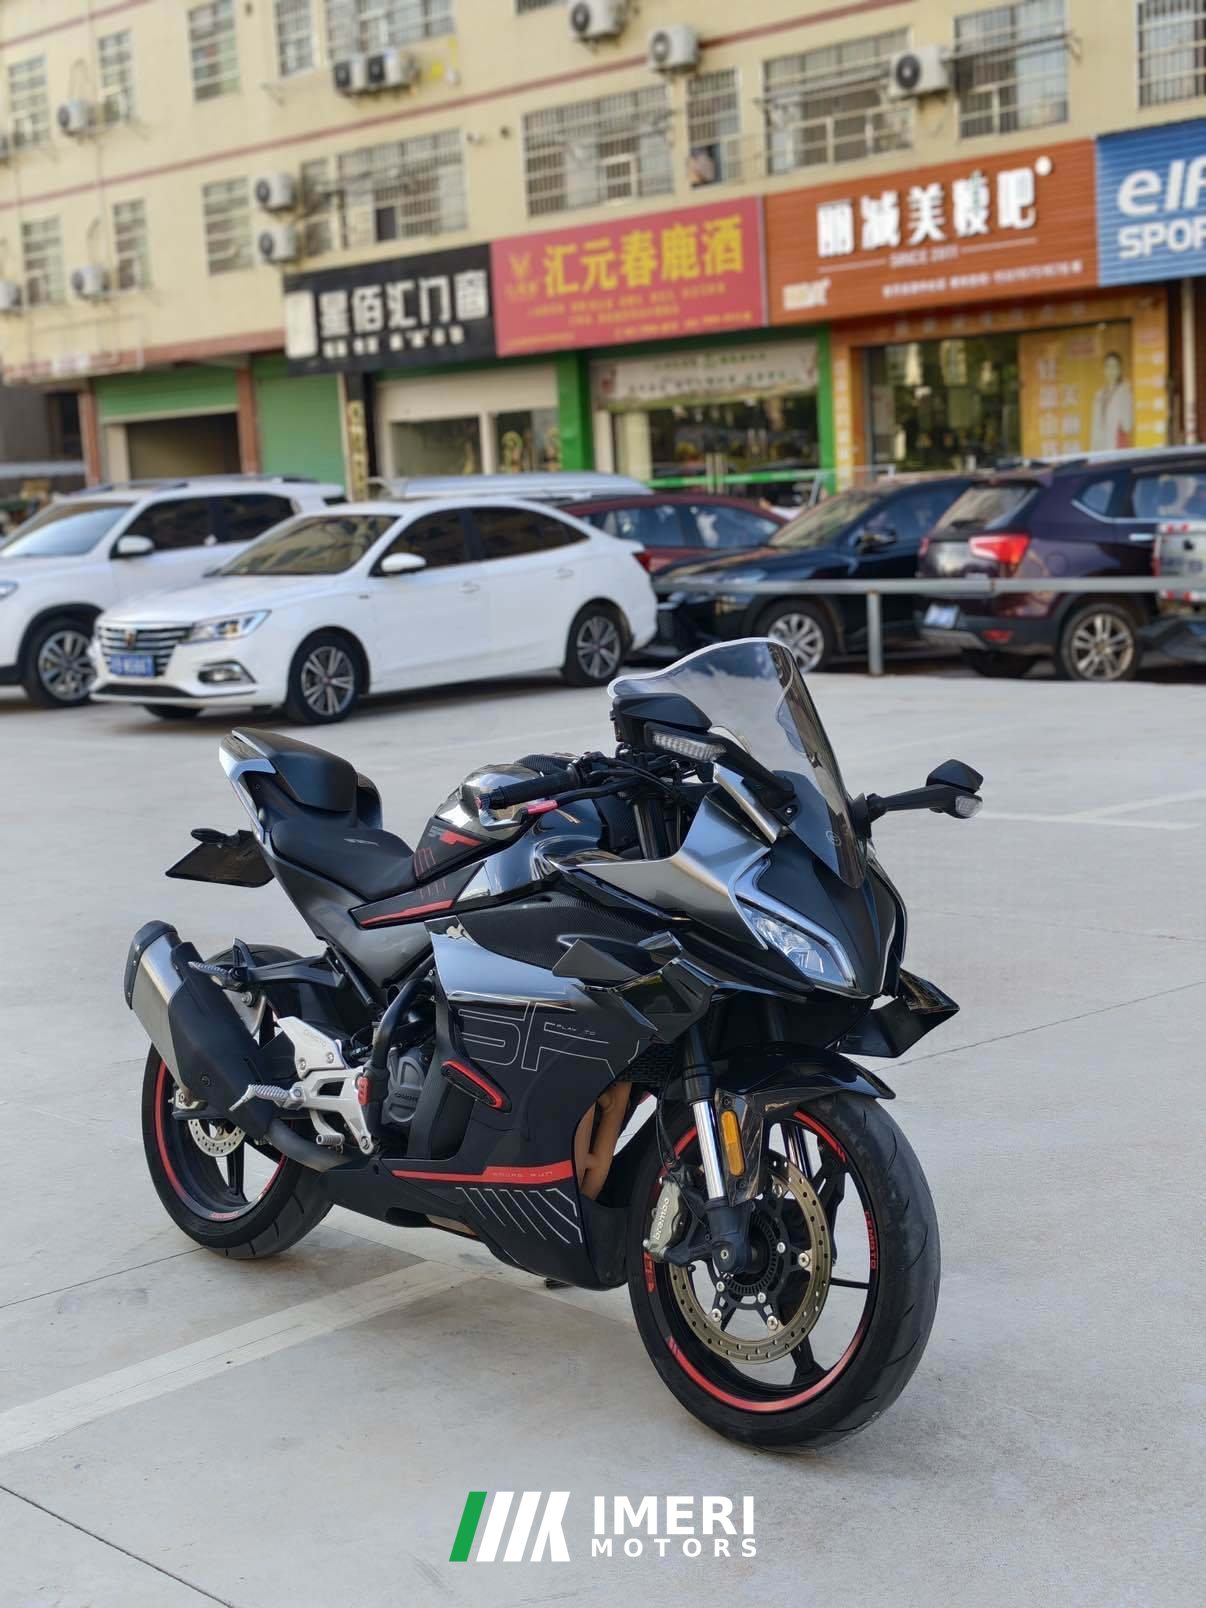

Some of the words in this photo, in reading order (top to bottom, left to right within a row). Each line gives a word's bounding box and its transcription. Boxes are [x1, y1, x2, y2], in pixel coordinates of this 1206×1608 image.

[543, 213, 743, 297] 汇元春鹿酒
[655, 1198, 669, 1241] brembo
